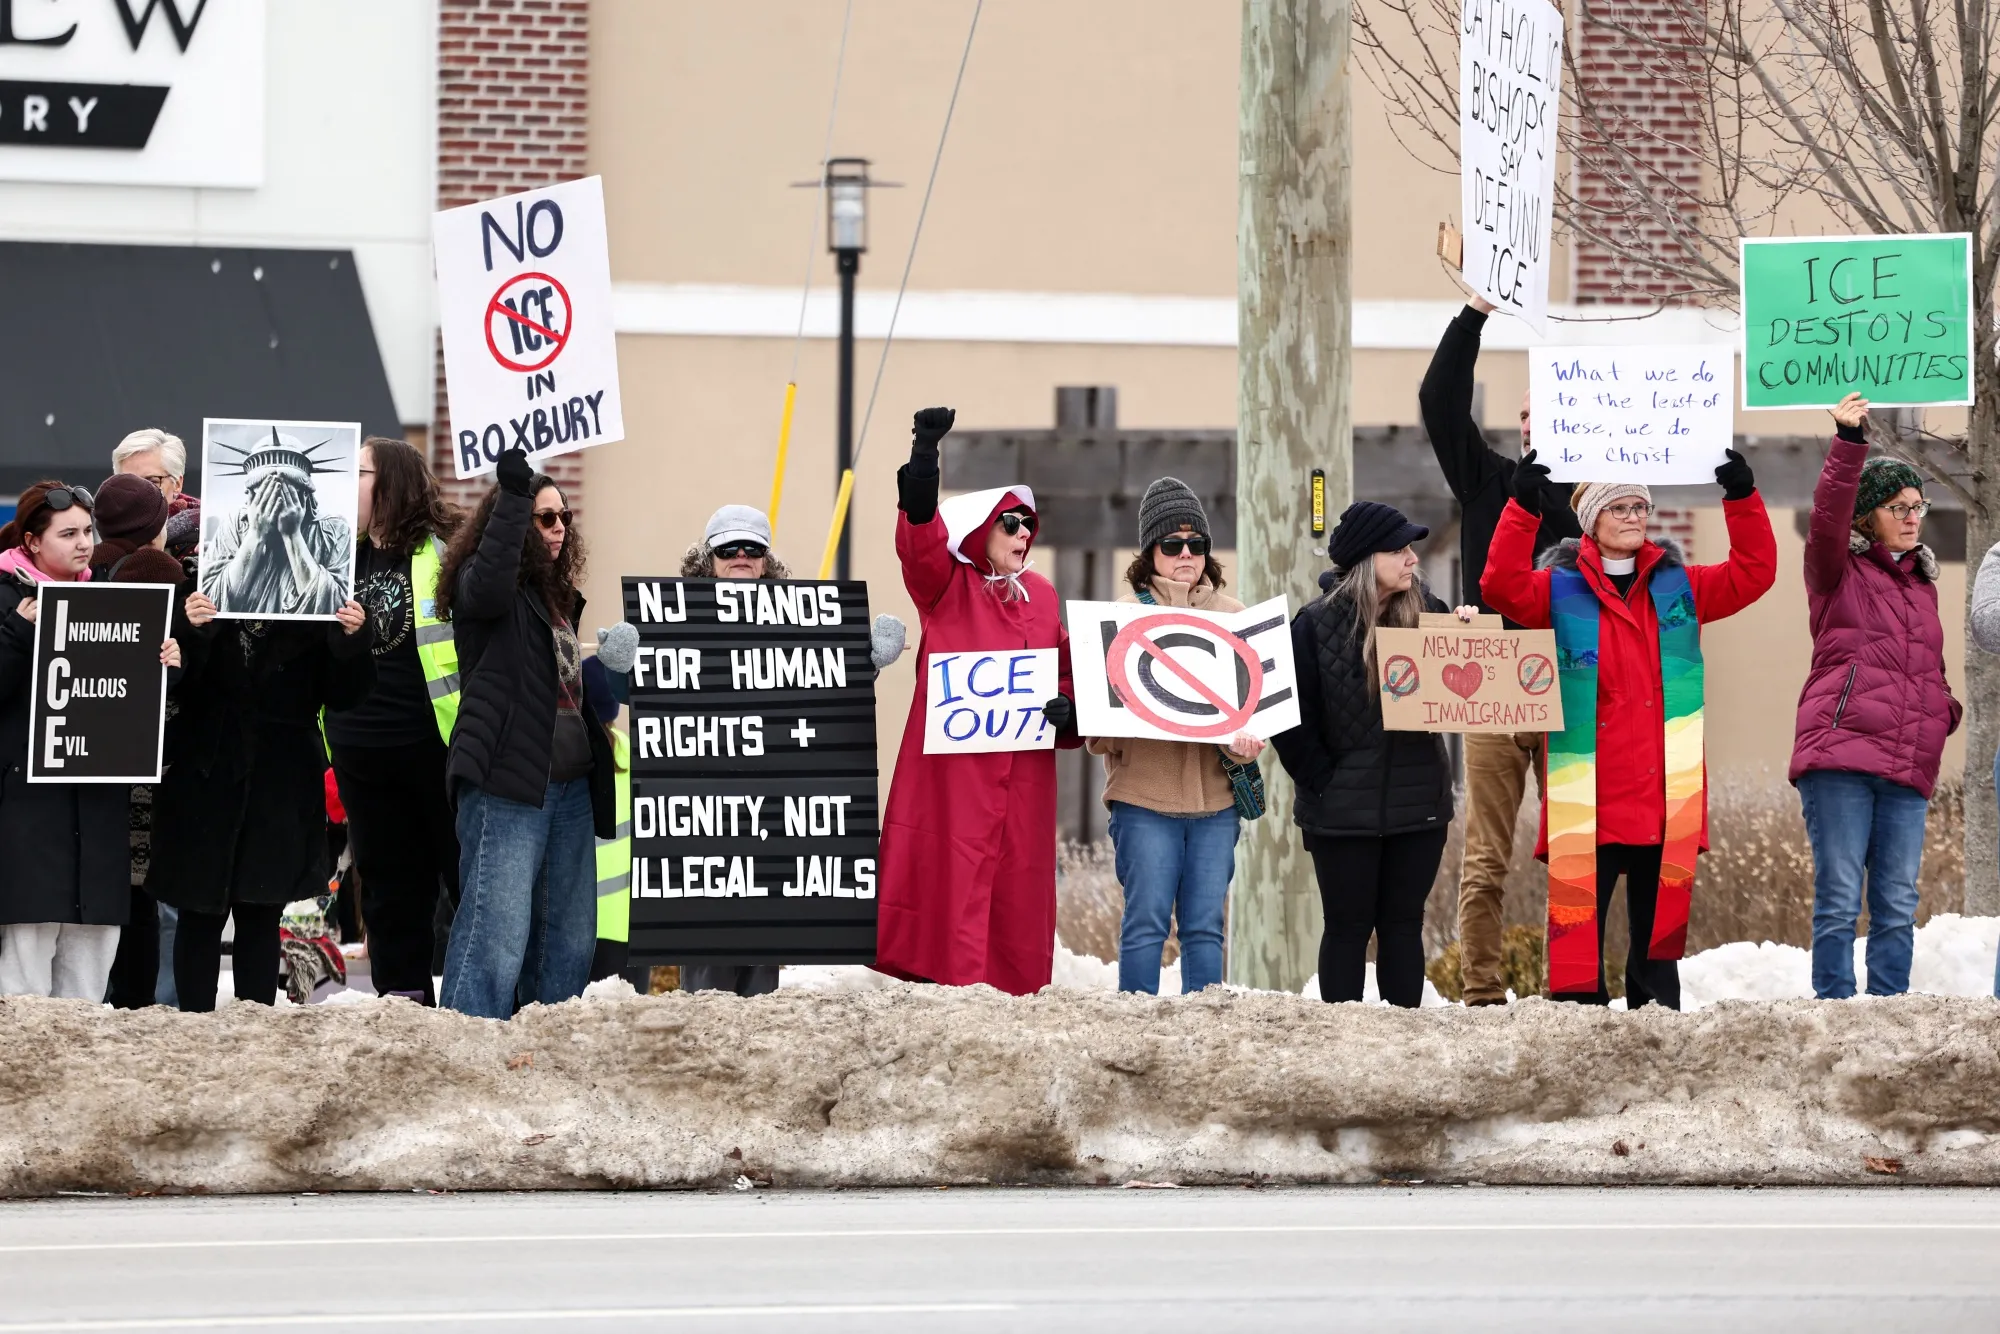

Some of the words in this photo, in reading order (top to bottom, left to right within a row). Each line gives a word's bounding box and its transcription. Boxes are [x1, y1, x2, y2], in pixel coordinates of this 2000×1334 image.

[1472, 61, 1546, 160] BISHOPS
[1499, 142, 1522, 182] SAY
[481, 199, 564, 272] NO
[1475, 167, 1541, 263] DEFUND
[1487, 244, 1527, 308] ICE
[1803, 254, 1902, 304] ICE
[504, 283, 559, 356] ICE
[1766, 309, 1947, 348] DESTOYS
[526, 370, 556, 400] IN
[1551, 360, 1621, 381] What
[1645, 368, 1678, 382] we
[1692, 360, 1714, 382] do
[1759, 351, 1968, 389] COMMUNITIES
[1551, 392, 1578, 407] to
[1593, 393, 1634, 409] the
[1652, 391, 1698, 409] least
[1703, 393, 1721, 408] of
[458, 390, 604, 472] ROXBURY
[1550, 418, 1612, 437] these,
[1625, 422, 1653, 436] we
[1667, 417, 1690, 436] do
[1559, 448, 1583, 463] to
[403, 587, 413, 604] LAW
[637, 582, 687, 623] NJ
[715, 583, 842, 626] STANDS
[54, 600, 141, 651] INHUMANE
[402, 607, 413, 632] DUTY
[633, 647, 701, 690] FOR
[730, 646, 847, 690] HUMAN
[1100, 614, 1293, 716] ICE
[1422, 636, 1460, 659] NEW
[1462, 637, 1520, 660] JERSEY
[46, 657, 128, 711] CALLOUS
[932, 655, 1037, 708] ICE
[943, 707, 1048, 742] OUT!
[1422, 701, 1548, 726] IMMIGRANTS
[637, 715, 765, 759] RIGHTS
[790, 718, 816, 748] +
[633, 795, 770, 841] DIGNITY,
[784, 795, 852, 837] NOT
[631, 855, 769, 899] ILLEGAL
[782, 855, 877, 899] JAILS
